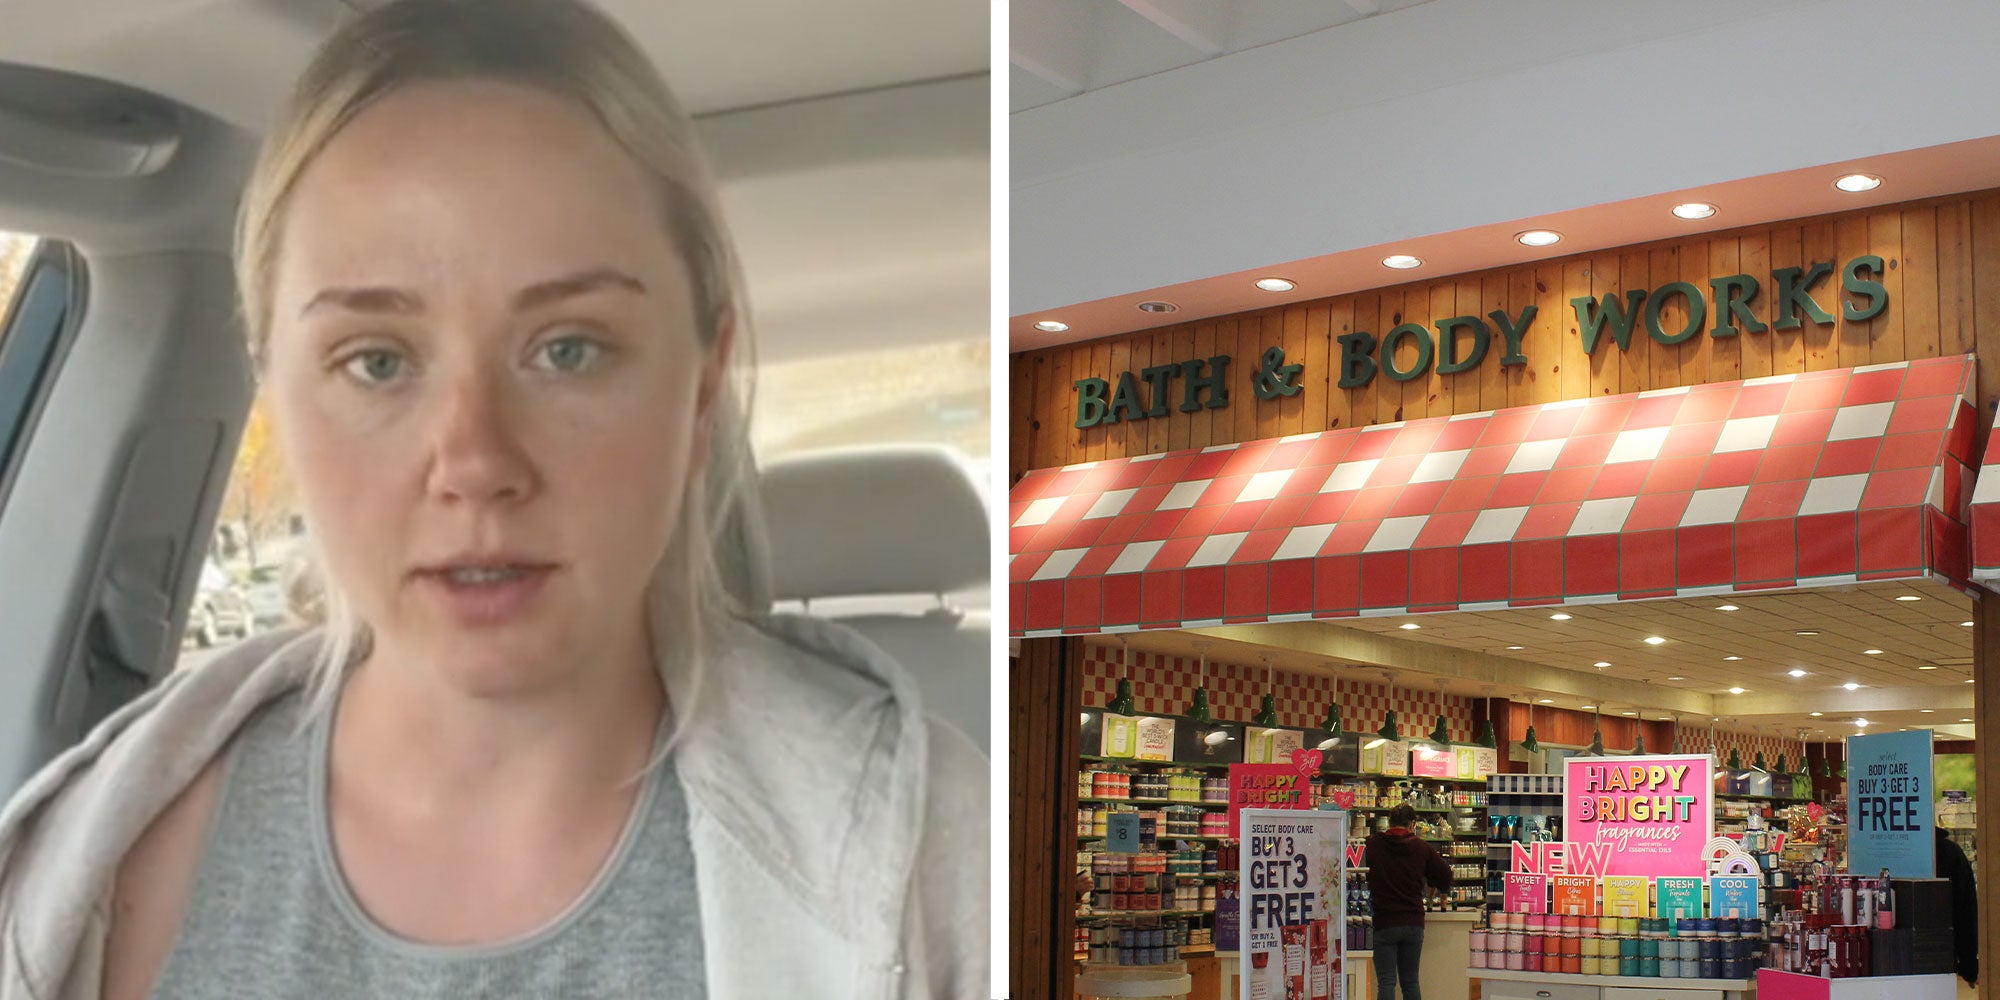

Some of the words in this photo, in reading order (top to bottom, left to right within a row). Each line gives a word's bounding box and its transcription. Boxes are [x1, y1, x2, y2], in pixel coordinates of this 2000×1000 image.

[1074, 355, 1231, 429] BATH
[1253, 346, 1304, 400] &
[1337, 305, 1538, 389] BODY
[1570, 255, 1888, 355] WORKS
[1868, 763, 1888, 776] BODY
[1889, 762, 1909, 776] CARE
[1241, 774, 1298, 789] HAPPY
[1585, 765, 1691, 792] HAPPY
[1858, 778, 1878, 795] BUY
[1912, 776, 1919, 793] 3
[1237, 789, 1302, 804] BRIGHT
[1578, 795, 1697, 823] BRIGHT
[1858, 795, 1921, 831] FREE
[1252, 824, 1276, 833] SELECT
[1278, 825, 1295, 834] BODY
[1297, 825, 1314, 834] CARE
[1595, 821, 1682, 852] fragrances
[1252, 836, 1282, 856] BUY
[1285, 836, 1294, 856] 3
[1511, 840, 1614, 880] NEW
[1250, 860, 1292, 889] GET
[1292, 853, 1308, 889] 3
[1510, 875, 1542, 885] SWEET
[1557, 878, 1592, 887] BRIGHT
[1609, 879, 1643, 888] HAPPY
[1664, 879, 1695, 889] FRESH
[1719, 879, 1749, 889] COOL
[1252, 892, 1315, 929] FREE
[1251, 933, 1259, 941] OR
[1260, 932, 1270, 940] BUY
[1251, 941, 1261, 949] GET
[1267, 940, 1279, 948] FREE
